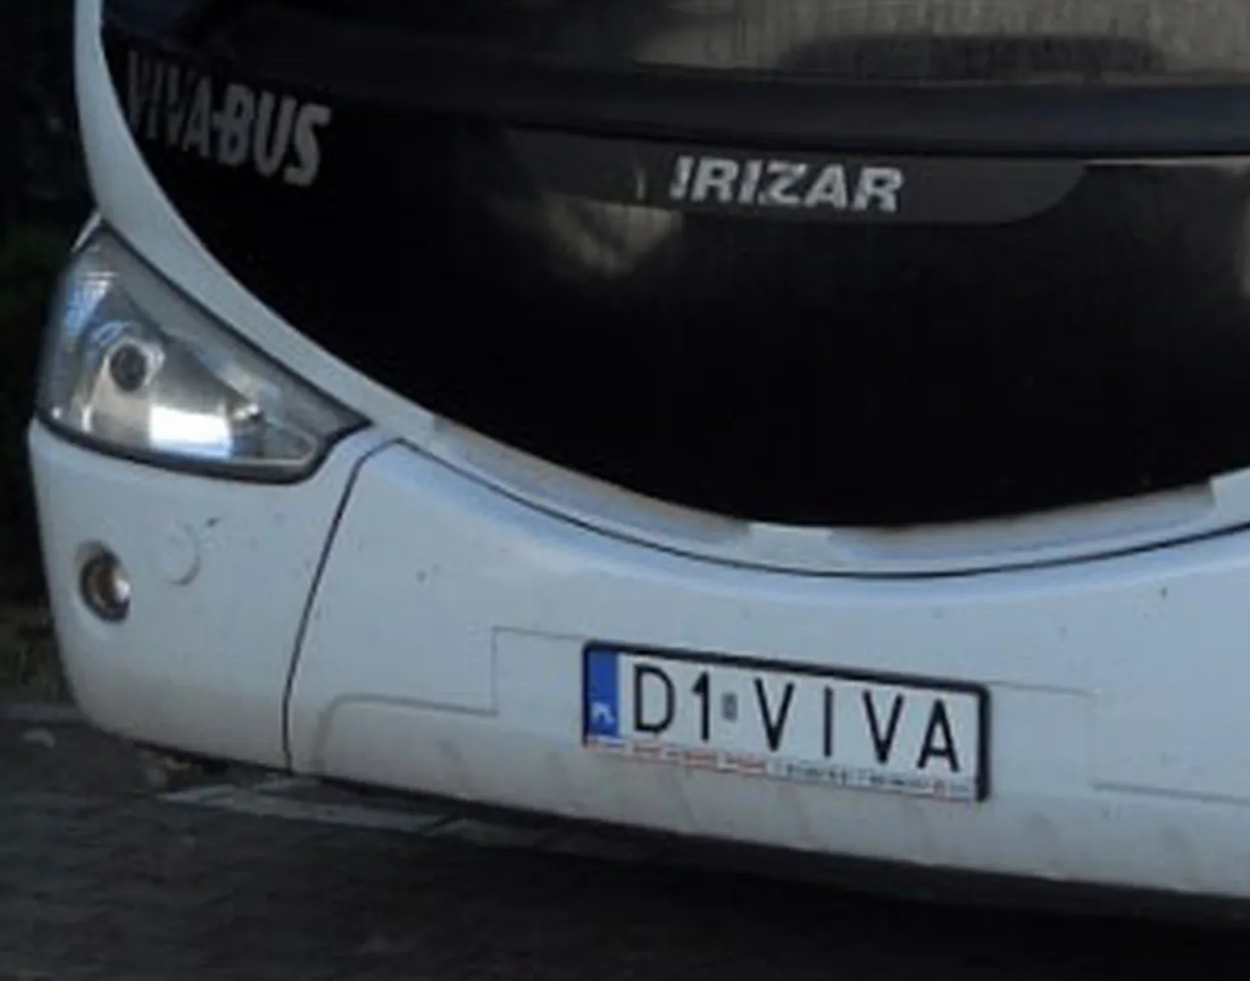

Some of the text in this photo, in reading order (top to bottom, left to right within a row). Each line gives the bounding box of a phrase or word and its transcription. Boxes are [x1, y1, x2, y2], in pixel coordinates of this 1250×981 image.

[670, 155, 904, 213] IRIZAR
[633, 665, 710, 741] D1
[754, 678, 959, 772] VIVA
